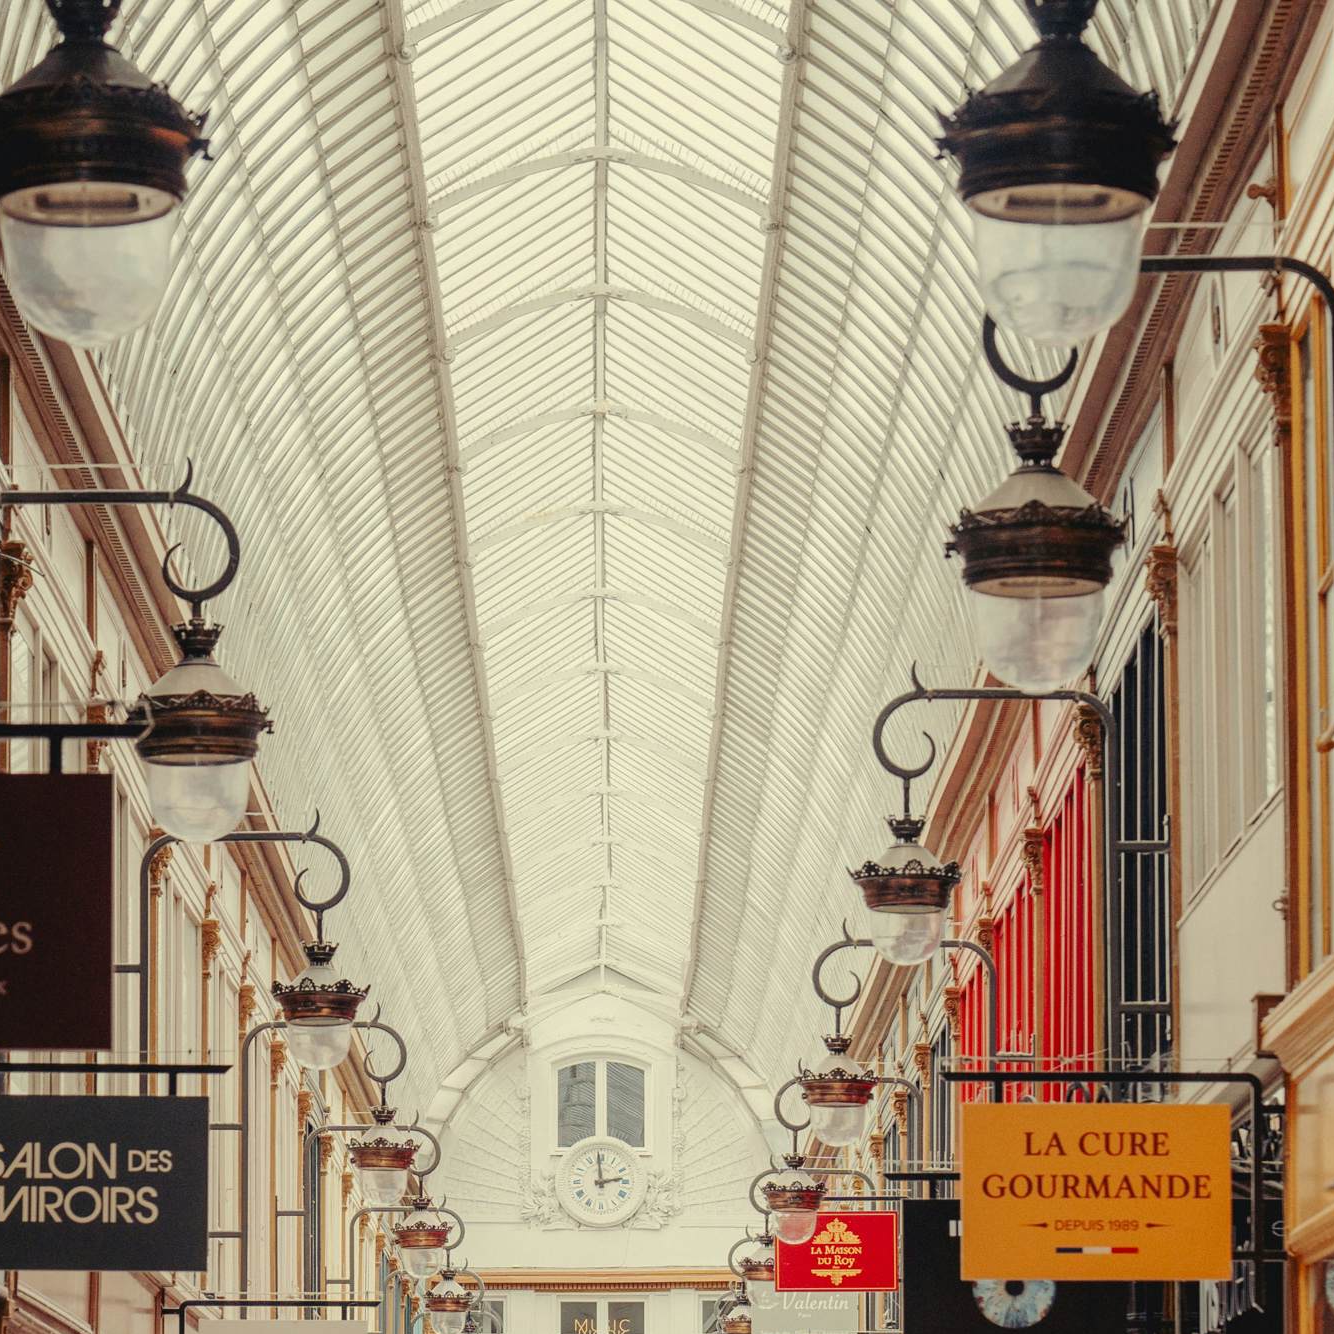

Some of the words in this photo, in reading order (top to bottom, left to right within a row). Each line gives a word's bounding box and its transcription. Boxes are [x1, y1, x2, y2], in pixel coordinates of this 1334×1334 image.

[1023, 1131, 1065, 1157] LA
[1078, 1131, 1171, 1157] CURE
[127, 1150, 173, 1173] DES
[982, 1173, 1212, 1199] GOURMANDE
[1054, 1219, 1104, 1232] DEPUIS
[1108, 1219, 1140, 1232] 1989
[811, 1247, 823, 1255] LA
[818, 1257, 832, 1265] DU
[782, 1292, 850, 1311] Valentin
[574, 1318, 631, 1333] MUIC
